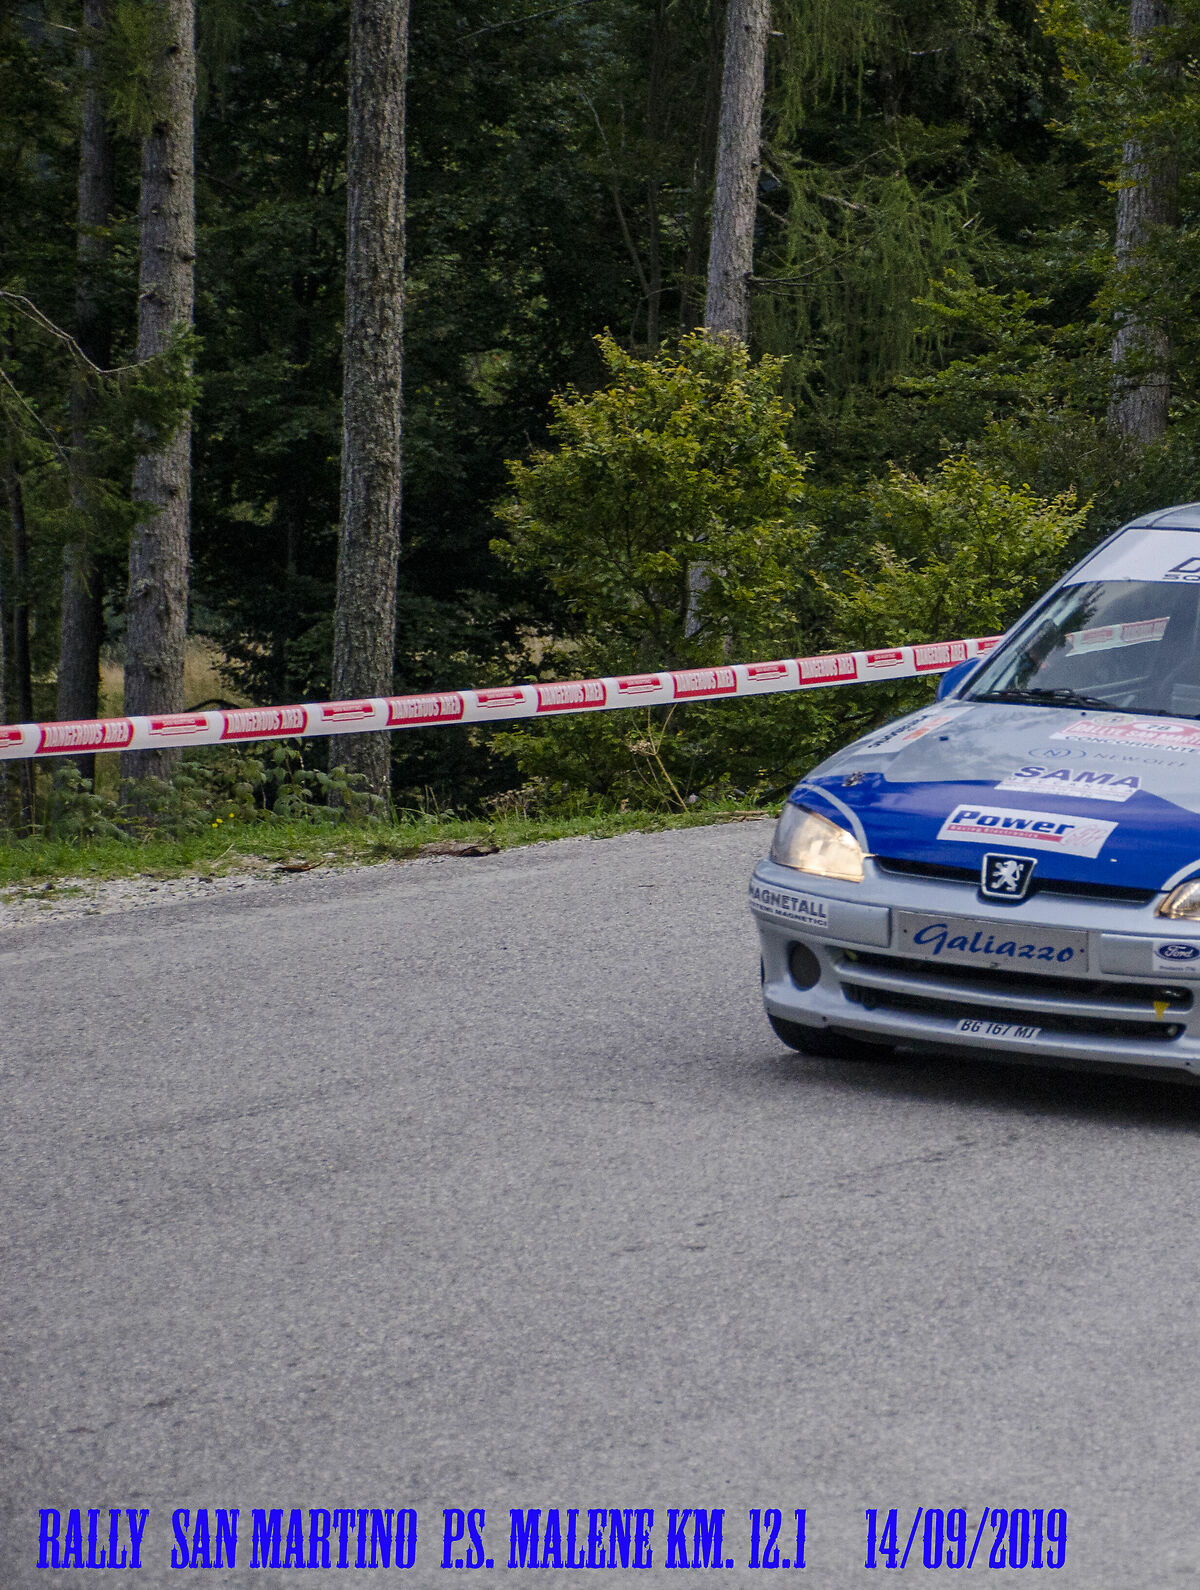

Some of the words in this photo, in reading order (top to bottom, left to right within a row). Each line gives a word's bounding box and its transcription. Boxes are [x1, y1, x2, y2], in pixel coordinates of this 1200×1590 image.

[914, 645, 950, 666] DANGEROUS
[950, 642, 966, 662] AREA
[800, 658, 838, 679] DANGEROUS
[838, 655, 856, 675] AREA
[675, 670, 716, 692] DANGEROUS
[717, 668, 736, 688] AREA
[539, 684, 584, 706] DANGEROUS
[584, 681, 604, 702] AREA
[390, 696, 439, 719] DANGEROUS
[440, 694, 462, 715] AREA
[227, 709, 281, 734] DANGEROUS
[281, 707, 304, 729] AREA
[44, 724, 103, 747] DANGEROUS
[104, 721, 130, 743] AREA
[1065, 736, 1197, 753] CONCORRENTE
[1014, 766, 1140, 789] SAMA
[952, 810, 1075, 835] Power
[775, 909, 827, 926] MAGNETICI
[913, 923, 1074, 963] Galiazzo
[1164, 945, 1194, 958] Ford
[960, 1019, 983, 1033] BG
[985, 1022, 1012, 1036] 167
